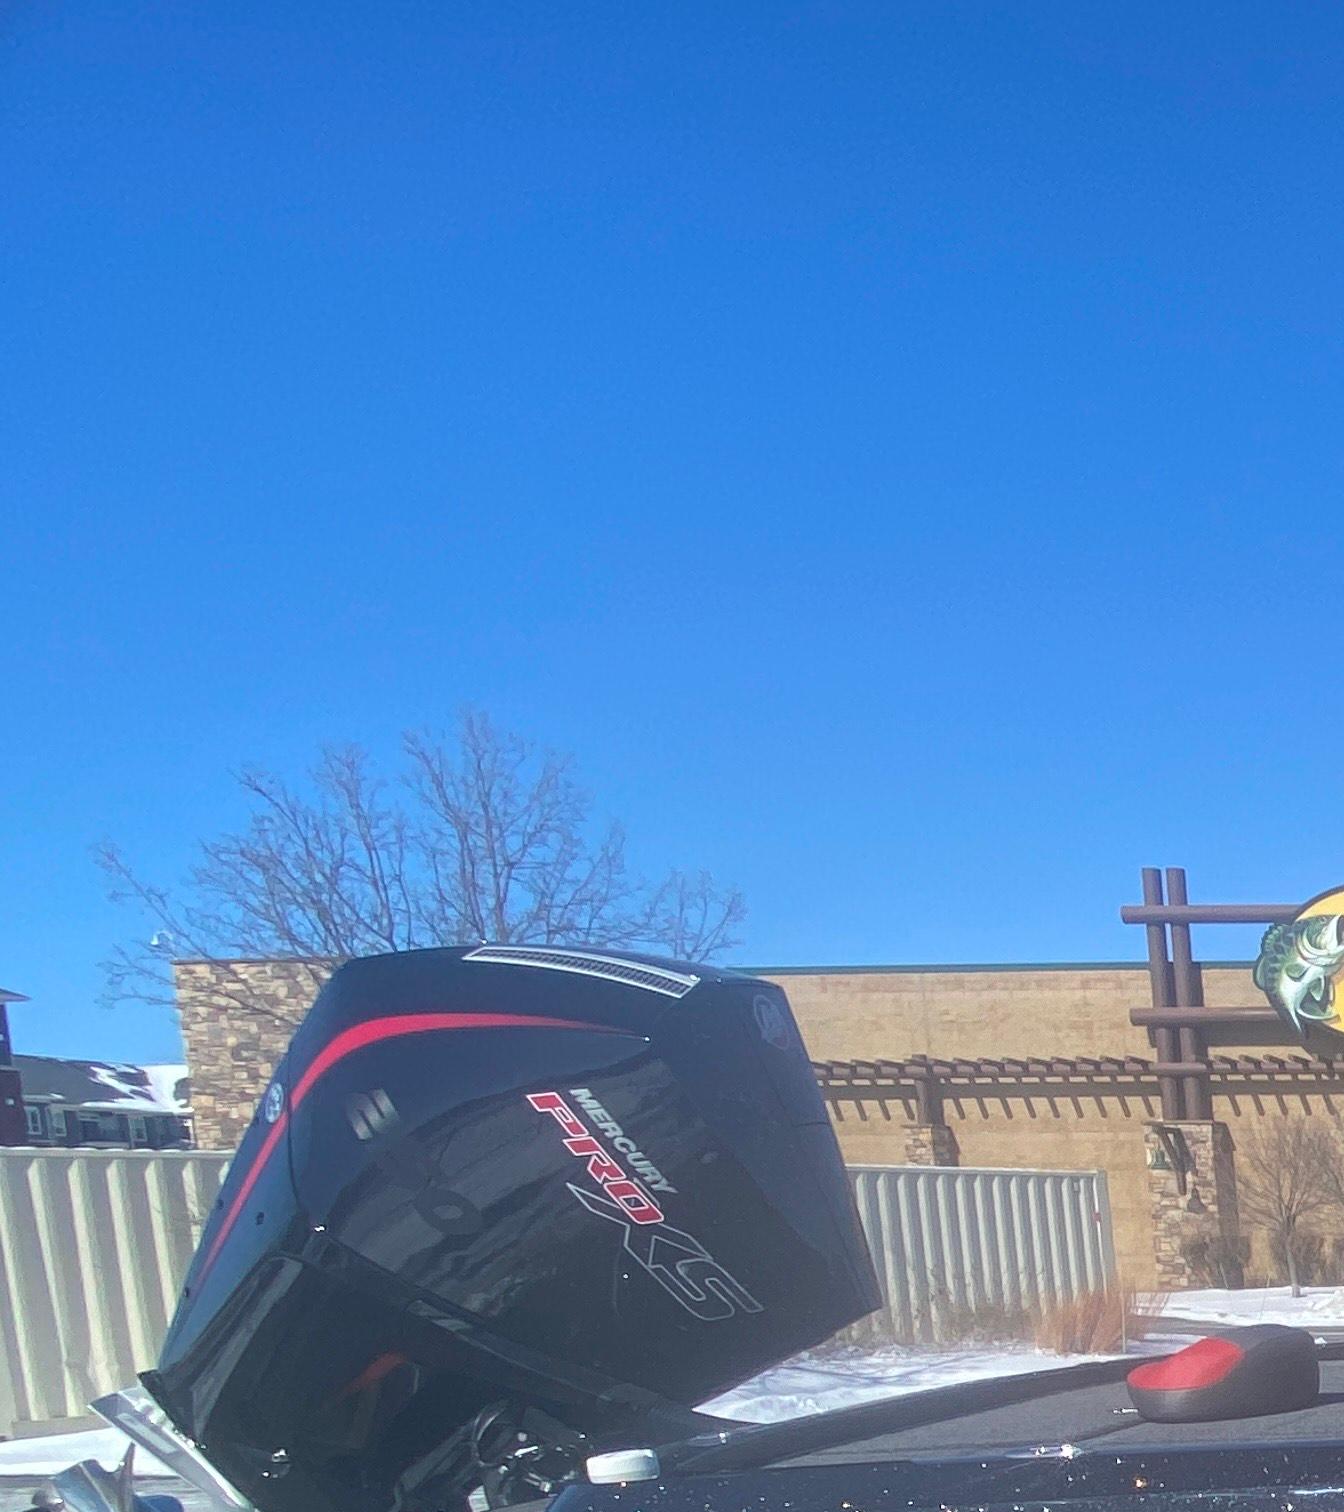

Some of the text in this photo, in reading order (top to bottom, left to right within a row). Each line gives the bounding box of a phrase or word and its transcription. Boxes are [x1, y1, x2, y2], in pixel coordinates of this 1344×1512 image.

[525, 1091, 665, 1225] PRO
[568, 1088, 679, 1194] MERCURY
[566, 1177, 764, 1321] XS
